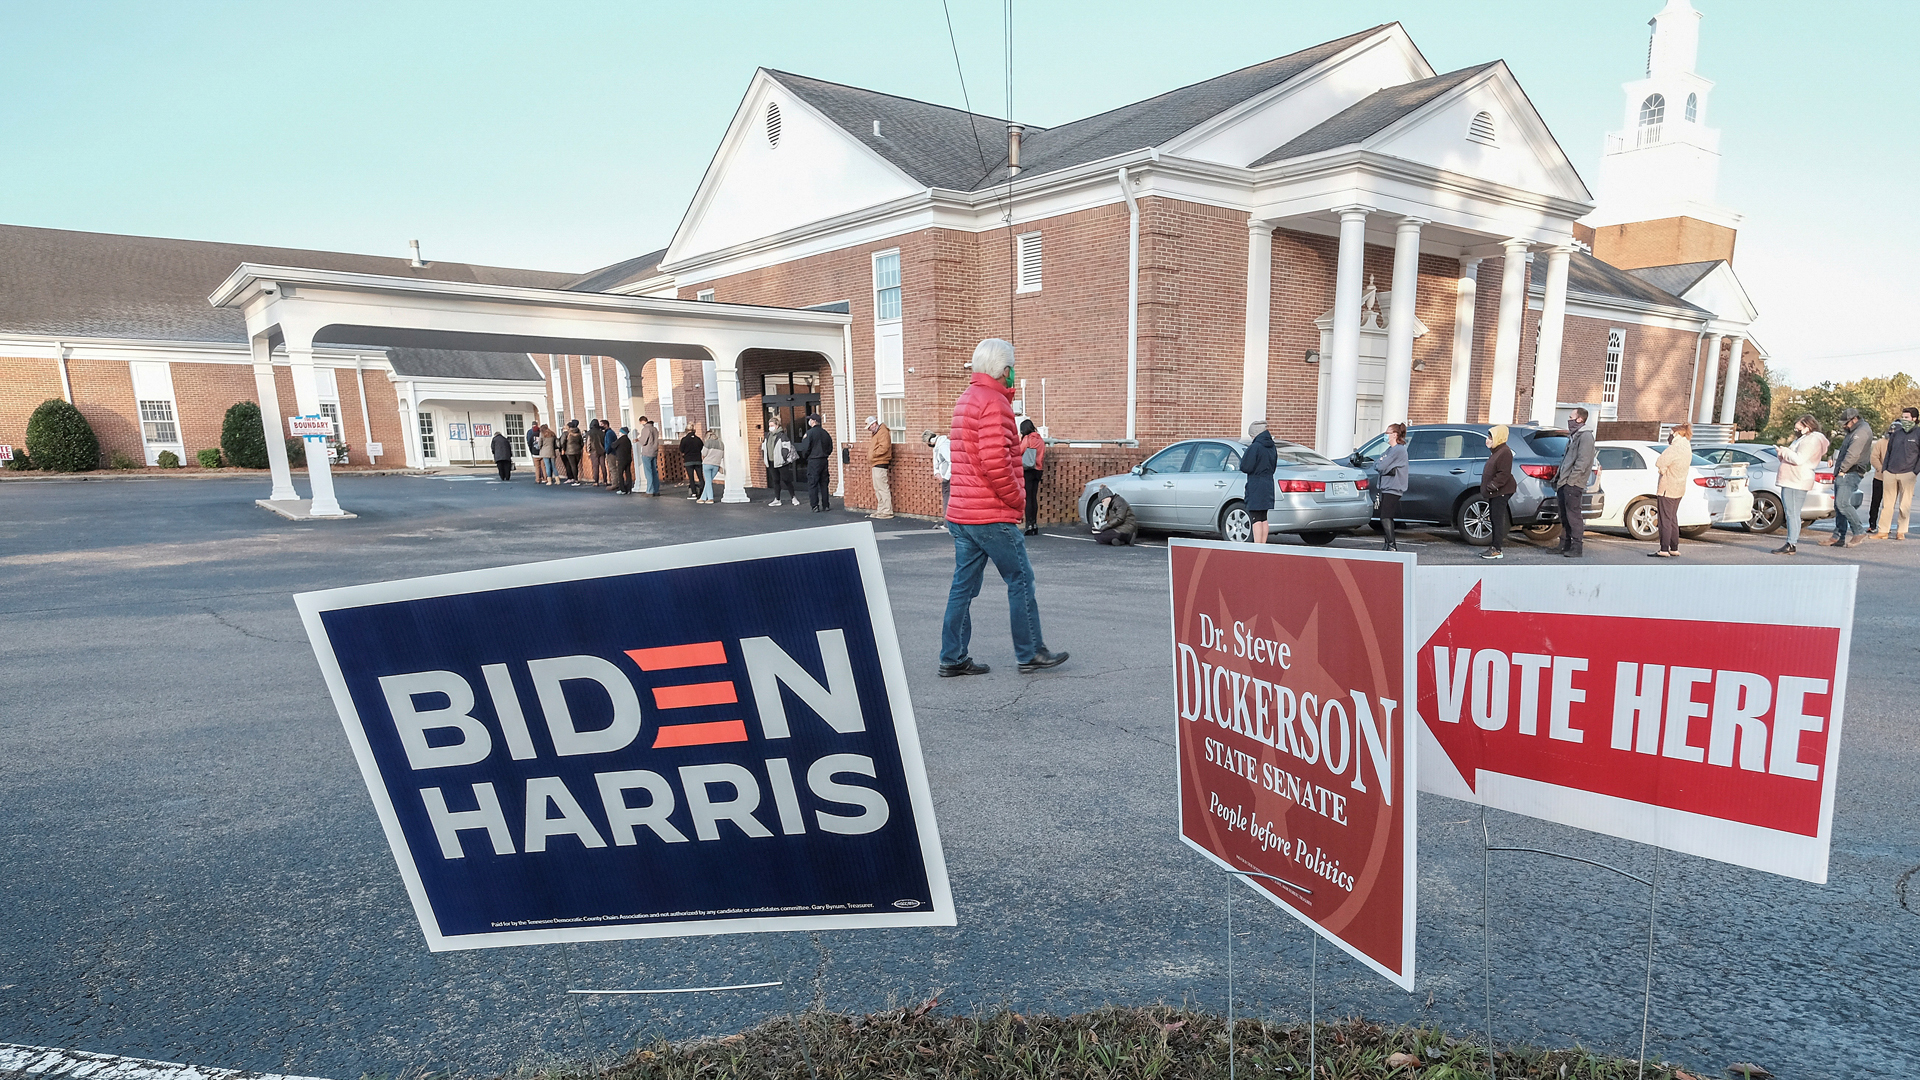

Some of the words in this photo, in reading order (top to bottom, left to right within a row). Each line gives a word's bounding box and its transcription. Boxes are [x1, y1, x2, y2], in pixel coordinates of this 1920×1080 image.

[1199, 613, 1228, 654] Dr.
[1233, 620, 1291, 670] Steve
[378, 629, 867, 771] BIDEN
[1178, 642, 1397, 807] DICKERSON
[1433, 645, 1588, 744] VOTE
[1610, 661, 1829, 781] HERE
[420, 753, 890, 860] HARRIS
[1205, 736, 1258, 784] STATE
[1263, 761, 1348, 827] SENATE
[1209, 791, 1247, 833] People
[1250, 811, 1290, 857] before
[1294, 838, 1354, 893] Politics
[553, 916, 583, 924] Democratic
[780, 904, 810, 912] committee.
